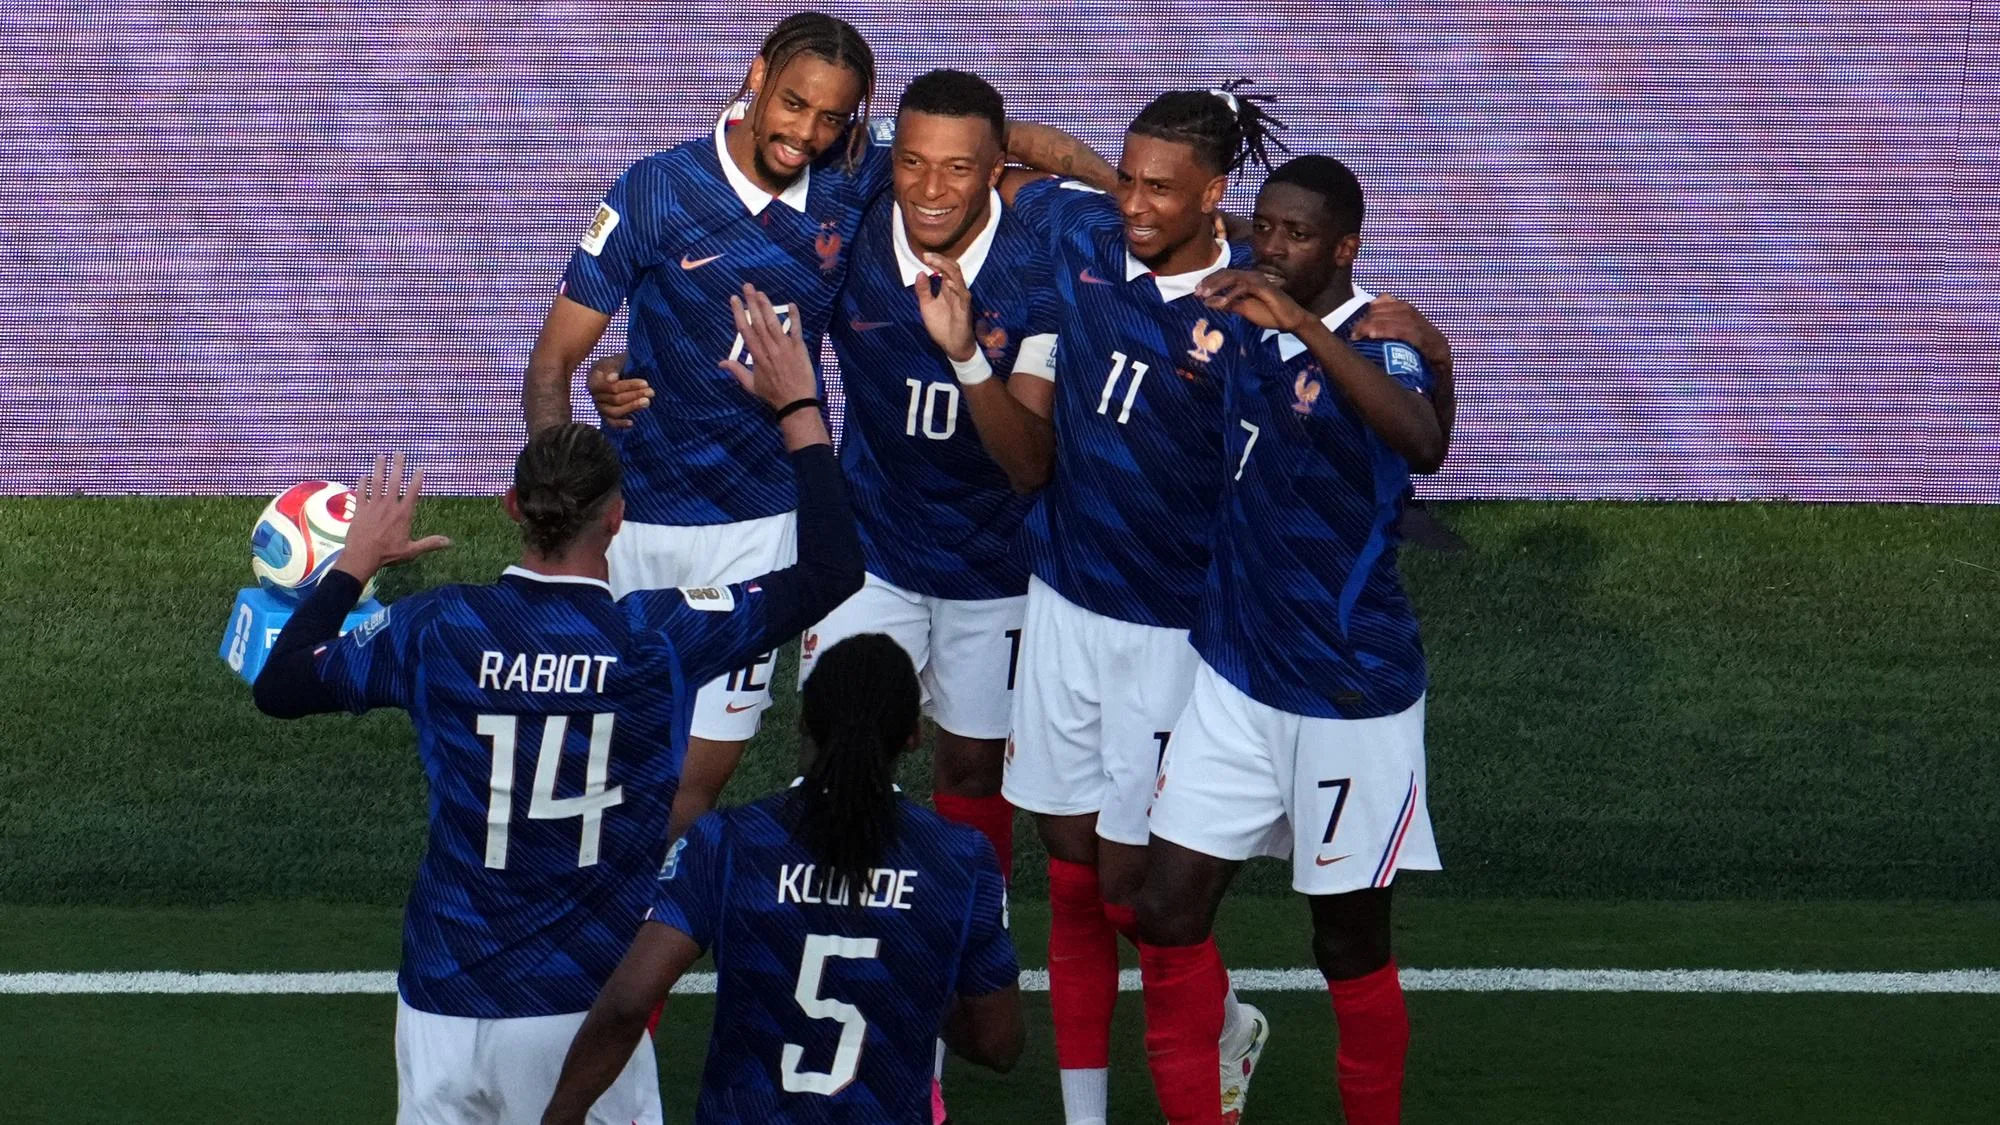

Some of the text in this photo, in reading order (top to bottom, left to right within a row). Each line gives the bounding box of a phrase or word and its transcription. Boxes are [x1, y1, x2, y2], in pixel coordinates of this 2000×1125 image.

[906, 378, 959, 440] 10
[1097, 350, 1149, 424] 11
[1234, 418, 1259, 481] 7
[479, 651, 617, 693] RABIOT
[1005, 628, 1021, 690] 1
[476, 712, 624, 869] 14
[1318, 778, 1351, 843] 7
[781, 934, 879, 1095] 5
